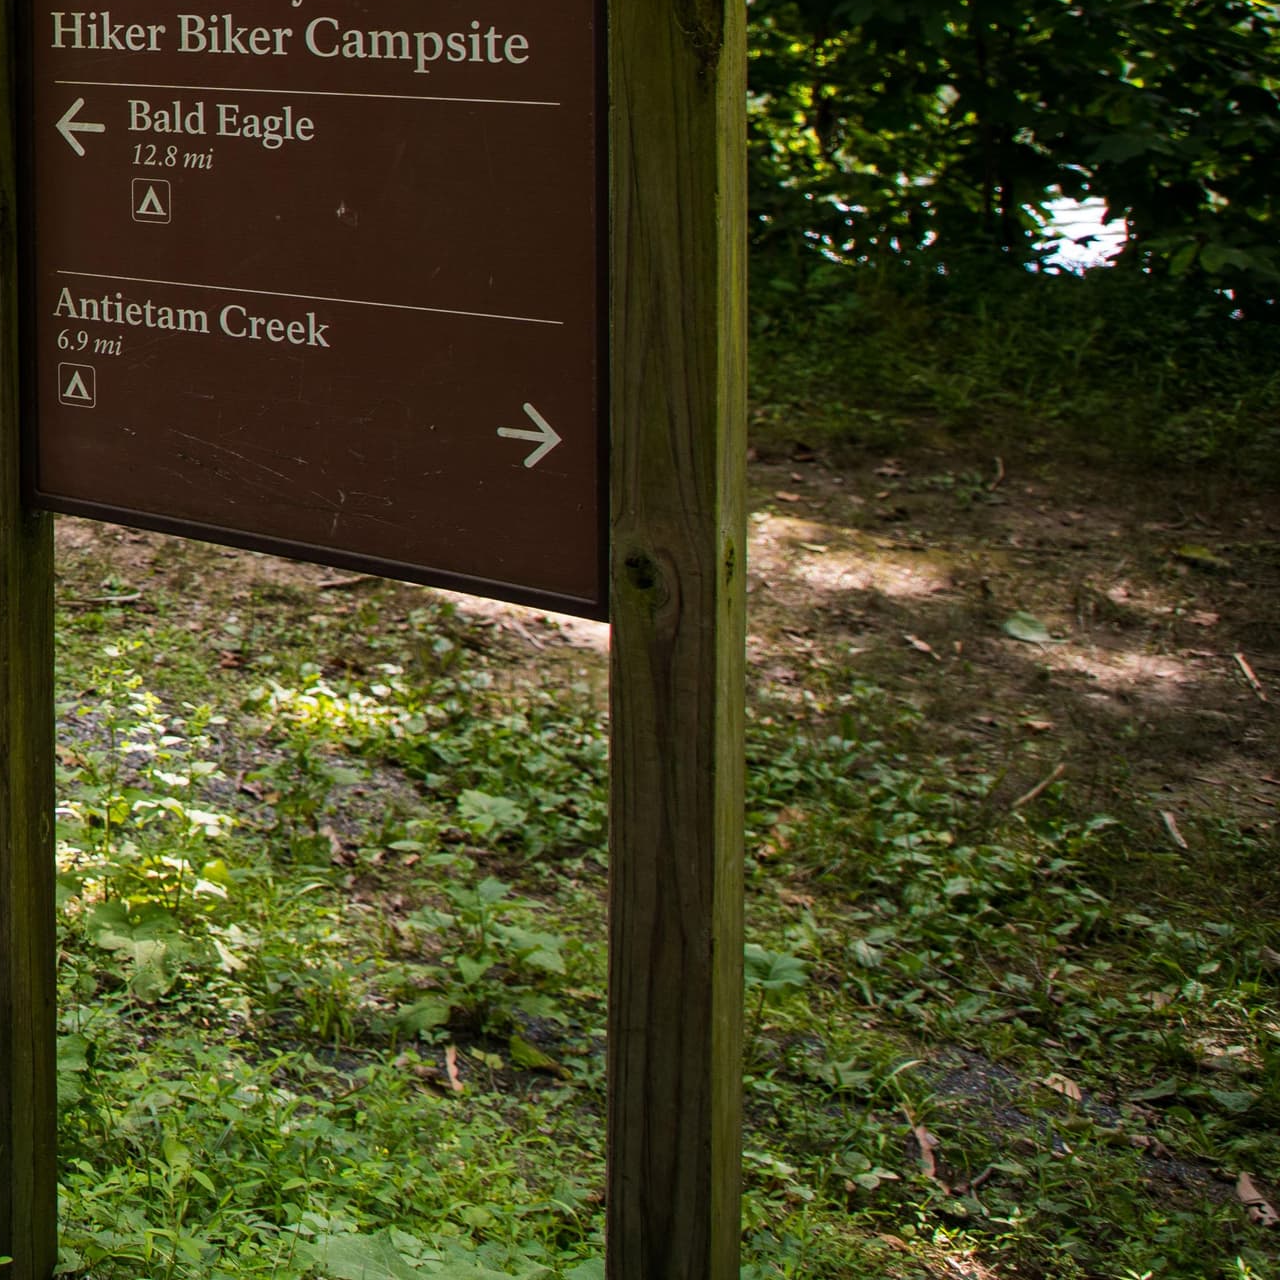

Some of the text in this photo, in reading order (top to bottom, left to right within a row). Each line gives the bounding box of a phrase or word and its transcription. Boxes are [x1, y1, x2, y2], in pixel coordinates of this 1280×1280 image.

[50, 10, 531, 74] Hiker Biker Campsite
[127, 99, 316, 150] Bald Eagle
[131, 143, 215, 171] 12.8 mi
[52, 286, 332, 349] Antietam Creek
[57, 328, 124, 357] 6.9 mi
